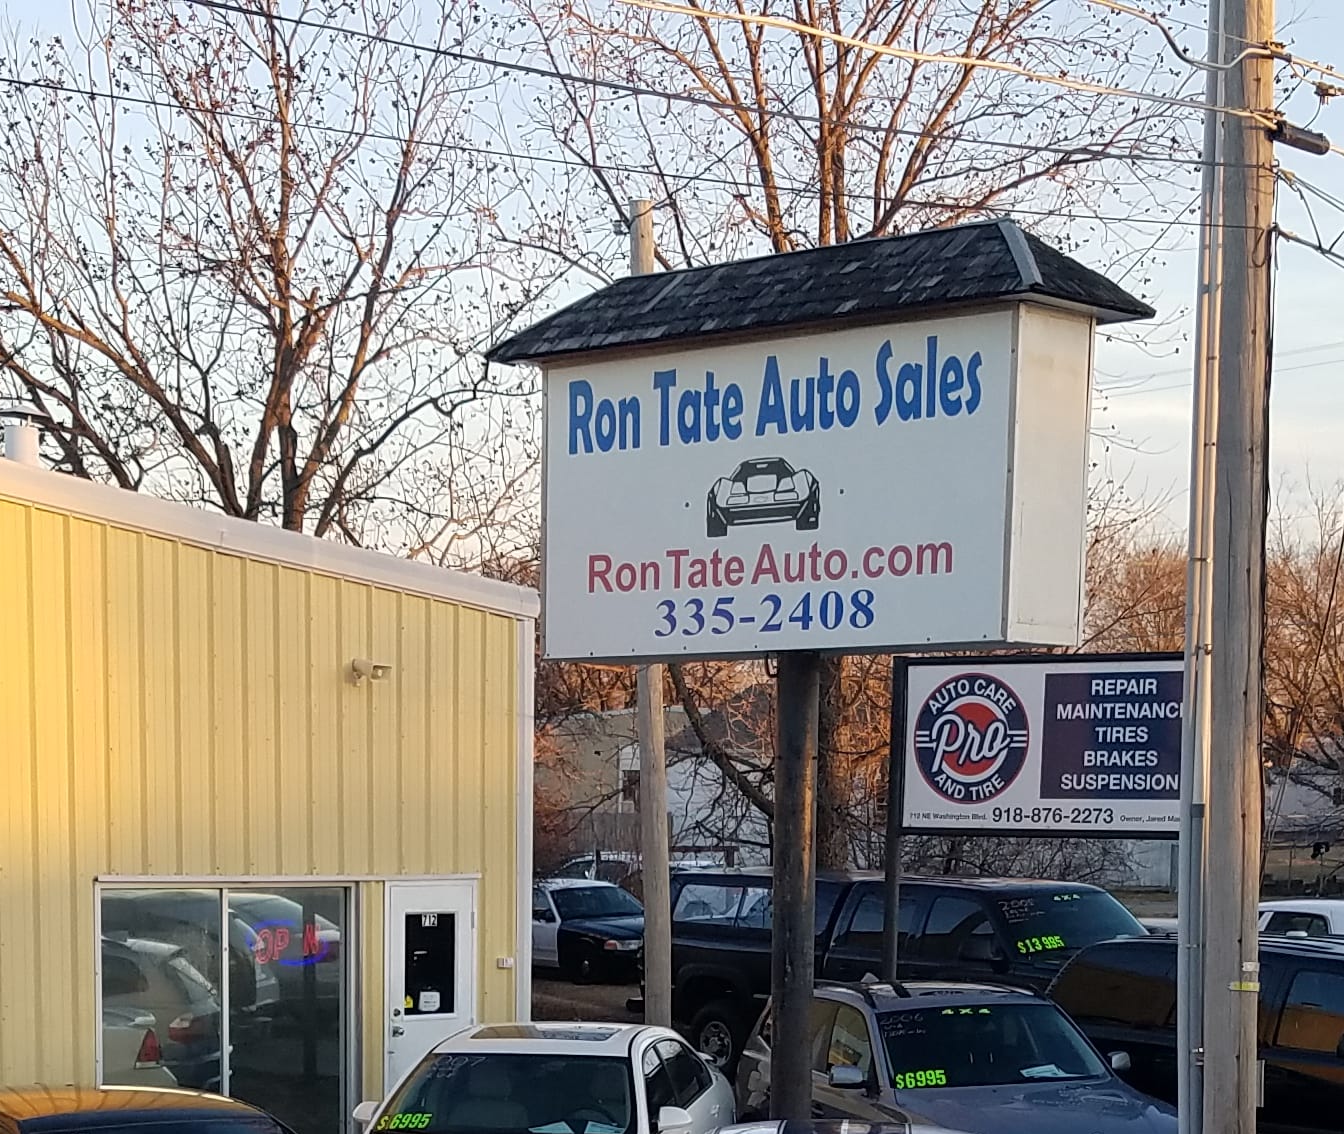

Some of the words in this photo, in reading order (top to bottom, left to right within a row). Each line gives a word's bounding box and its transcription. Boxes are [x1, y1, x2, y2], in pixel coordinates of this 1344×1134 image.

[567, 378, 641, 455] Ron
[653, 368, 743, 447] Tate
[755, 355, 861, 436] Auto
[874, 335, 983, 425] Sales
[654, 588, 876, 637] 335-2408
[1091, 679, 1158, 696] REPAIR
[928, 680, 970, 715] AUTO
[974, 680, 1016, 714] CARE
[931, 713, 1011, 773] Pro
[1095, 726, 1149, 743] TIRES
[1083, 750, 1158, 767] BRAKES
[934, 773, 965, 799] AND
[969, 774, 1005, 801] TIRE
[1060, 773, 1179, 791] SUSPENSION
[992, 807, 1114, 824] 918-876-2273
[422, 914, 437, 926] 712
[255, 922, 321, 964] OPN
[895, 1069, 947, 1089] $6995
[376, 1113, 433, 1131] $6995
